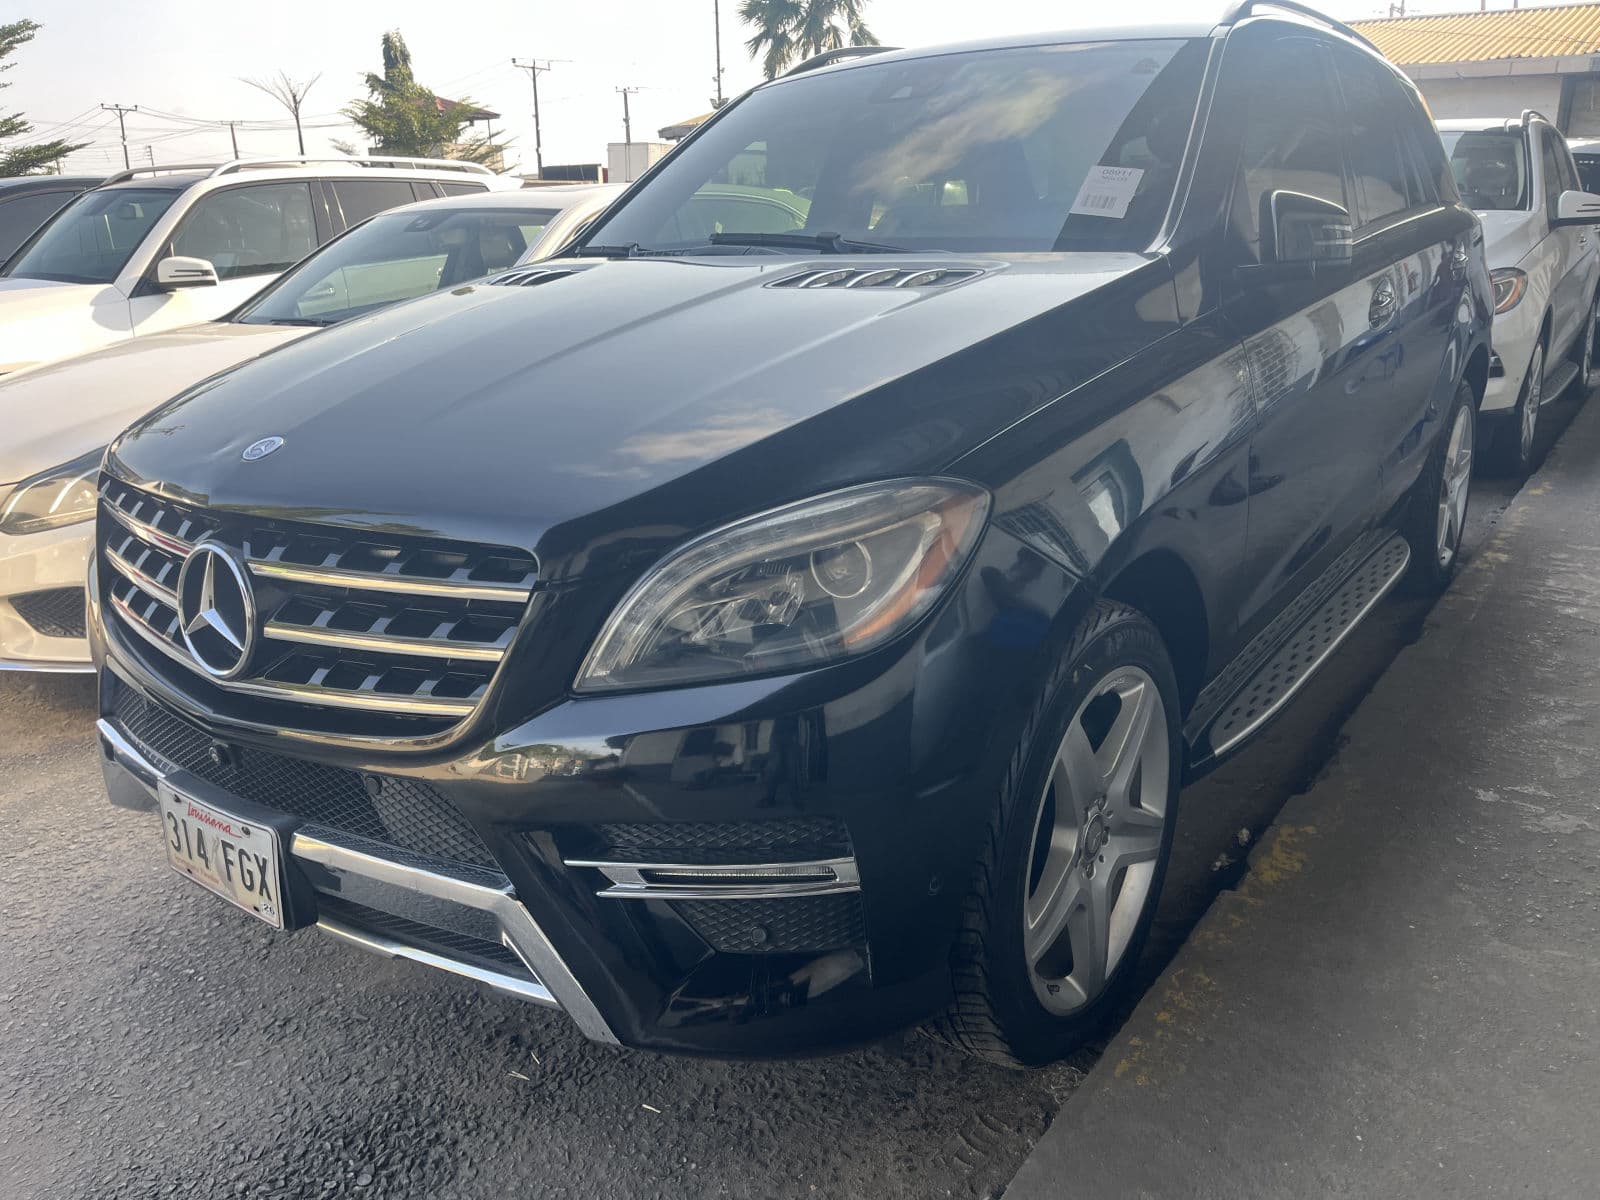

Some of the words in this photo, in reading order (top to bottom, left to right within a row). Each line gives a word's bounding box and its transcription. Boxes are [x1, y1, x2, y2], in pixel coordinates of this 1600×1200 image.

[187, 801, 242, 838] Louisiana
[166, 811, 210, 870] 314
[221, 839, 273, 902] FGX
